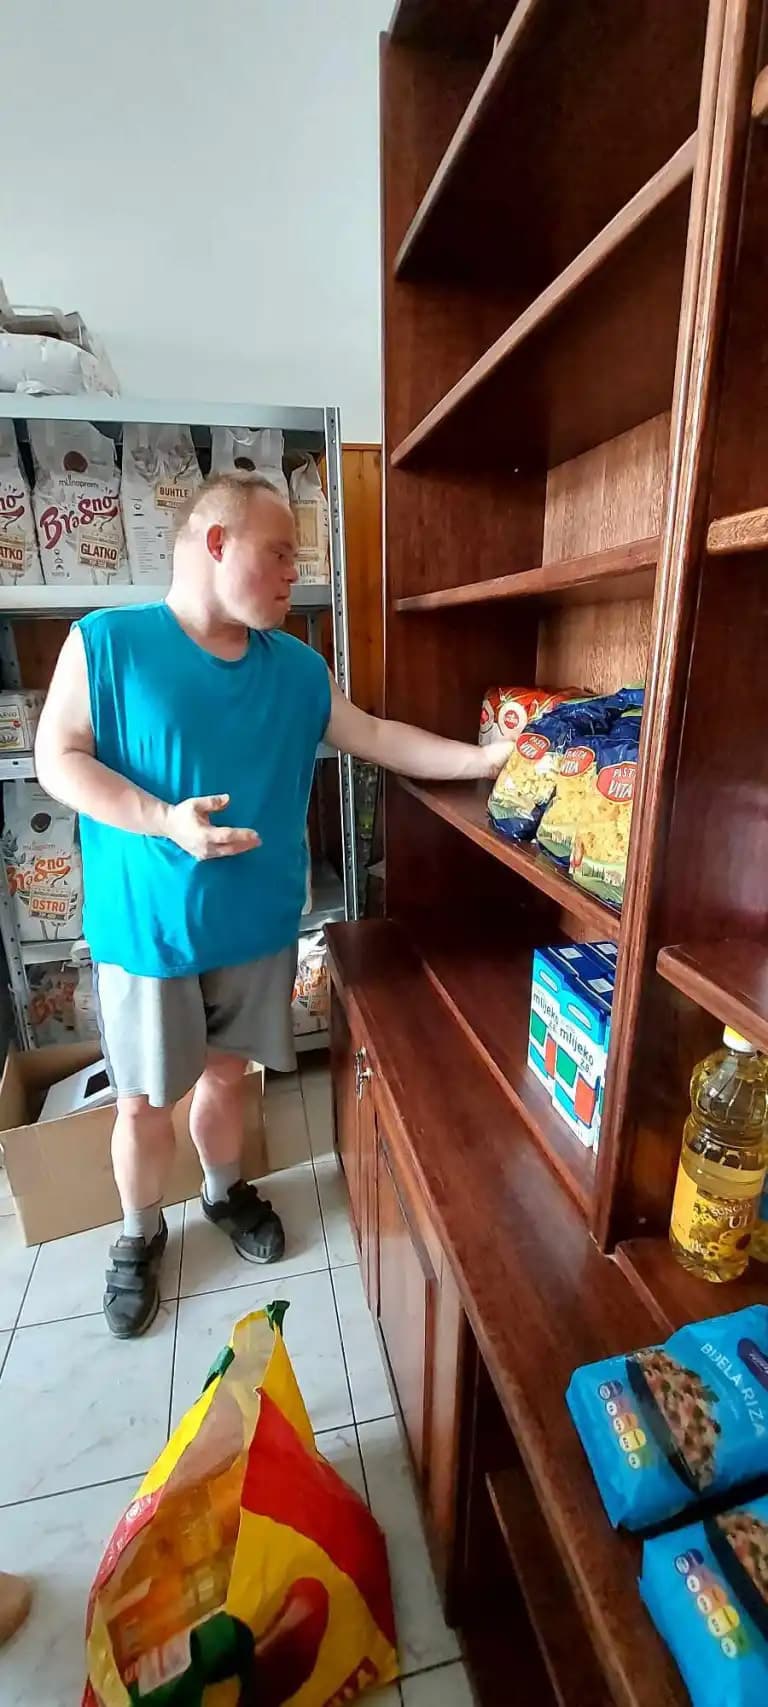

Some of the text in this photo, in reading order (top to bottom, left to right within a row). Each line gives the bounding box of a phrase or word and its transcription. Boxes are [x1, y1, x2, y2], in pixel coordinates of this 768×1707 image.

[159, 487, 190, 498] BUHTLE
[0, 547, 23, 560] ATKO
[80, 543, 117, 560] GLATKO
[607, 779, 633, 798] VITA
[31, 899, 67, 914] OSTRO
[533, 993, 559, 1025] mlijeko
[560, 1028, 594, 1067] mlijeko
[700, 1343, 743, 1387] BIJELA
